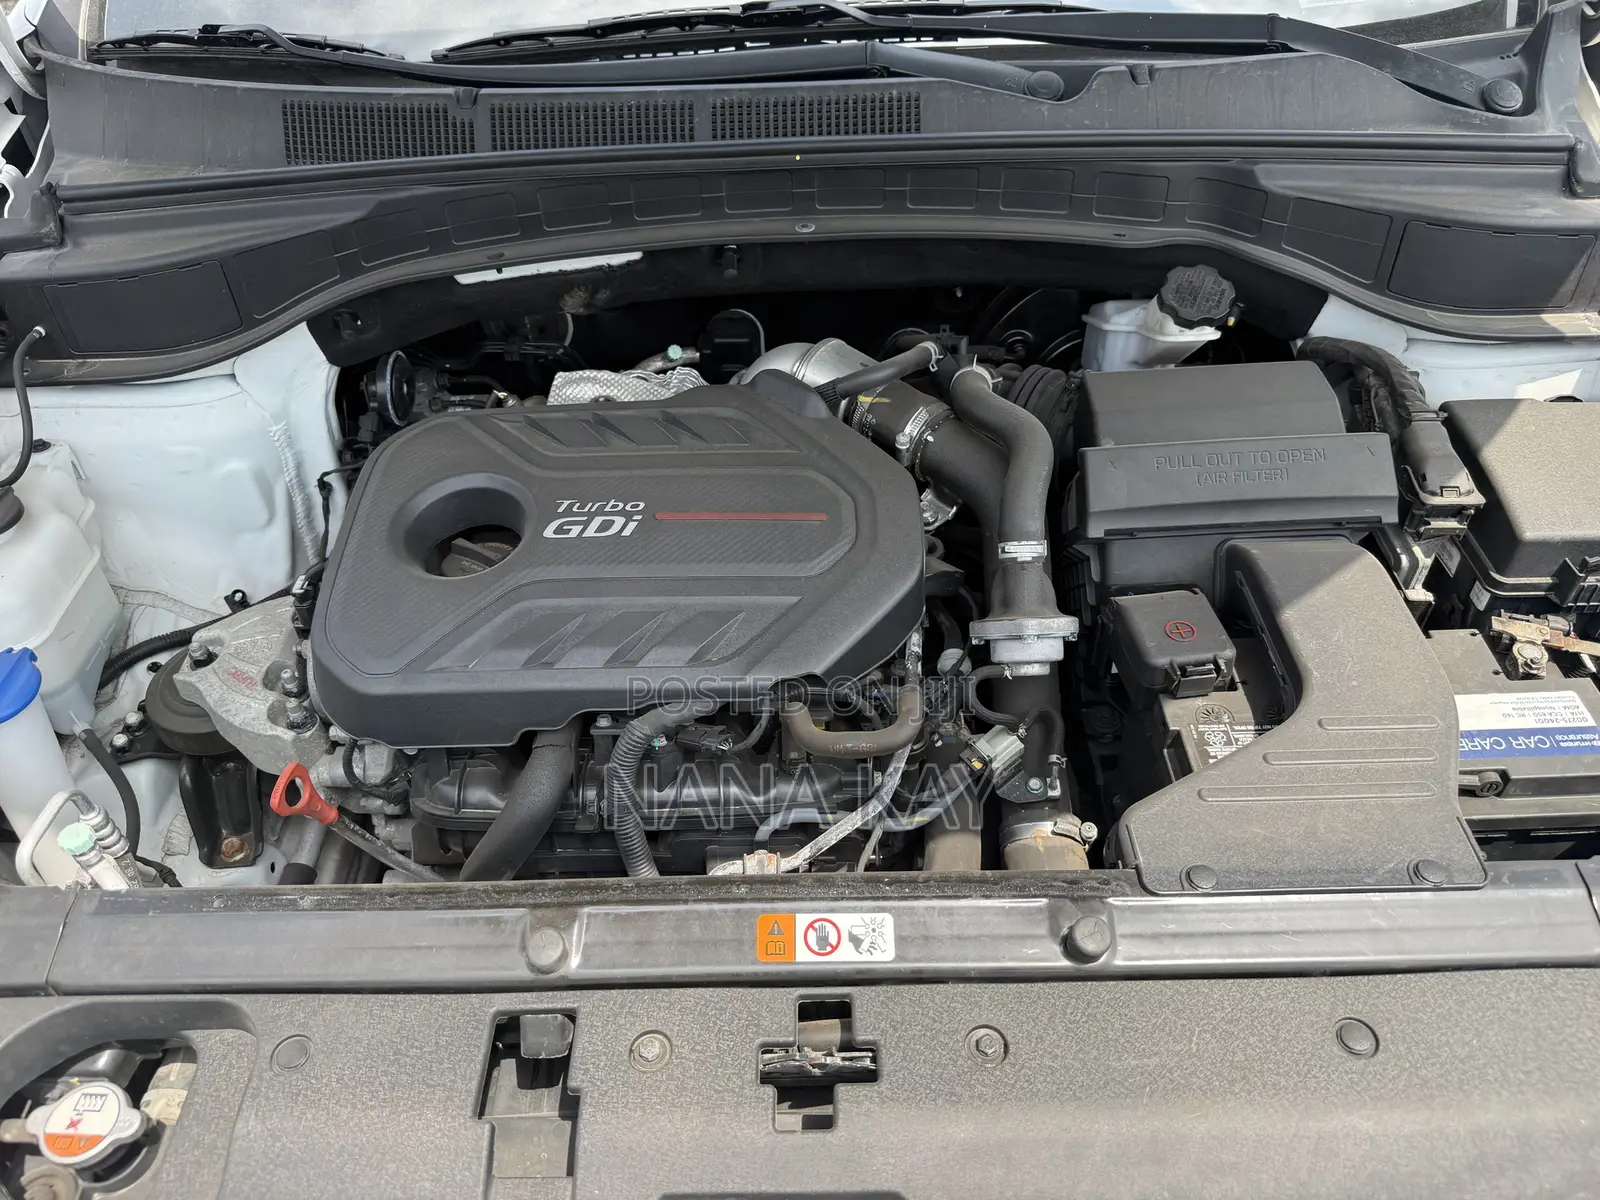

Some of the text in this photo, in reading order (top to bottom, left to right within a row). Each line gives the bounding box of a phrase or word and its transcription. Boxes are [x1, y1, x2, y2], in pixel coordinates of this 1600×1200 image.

[1154, 448, 1326, 471] PULL OUT TO OPEN
[556, 499, 646, 513] Turbo
[542, 515, 643, 538] GDi
[1508, 735, 1550, 749] CAR
[1555, 733, 1599, 741] Assurance
